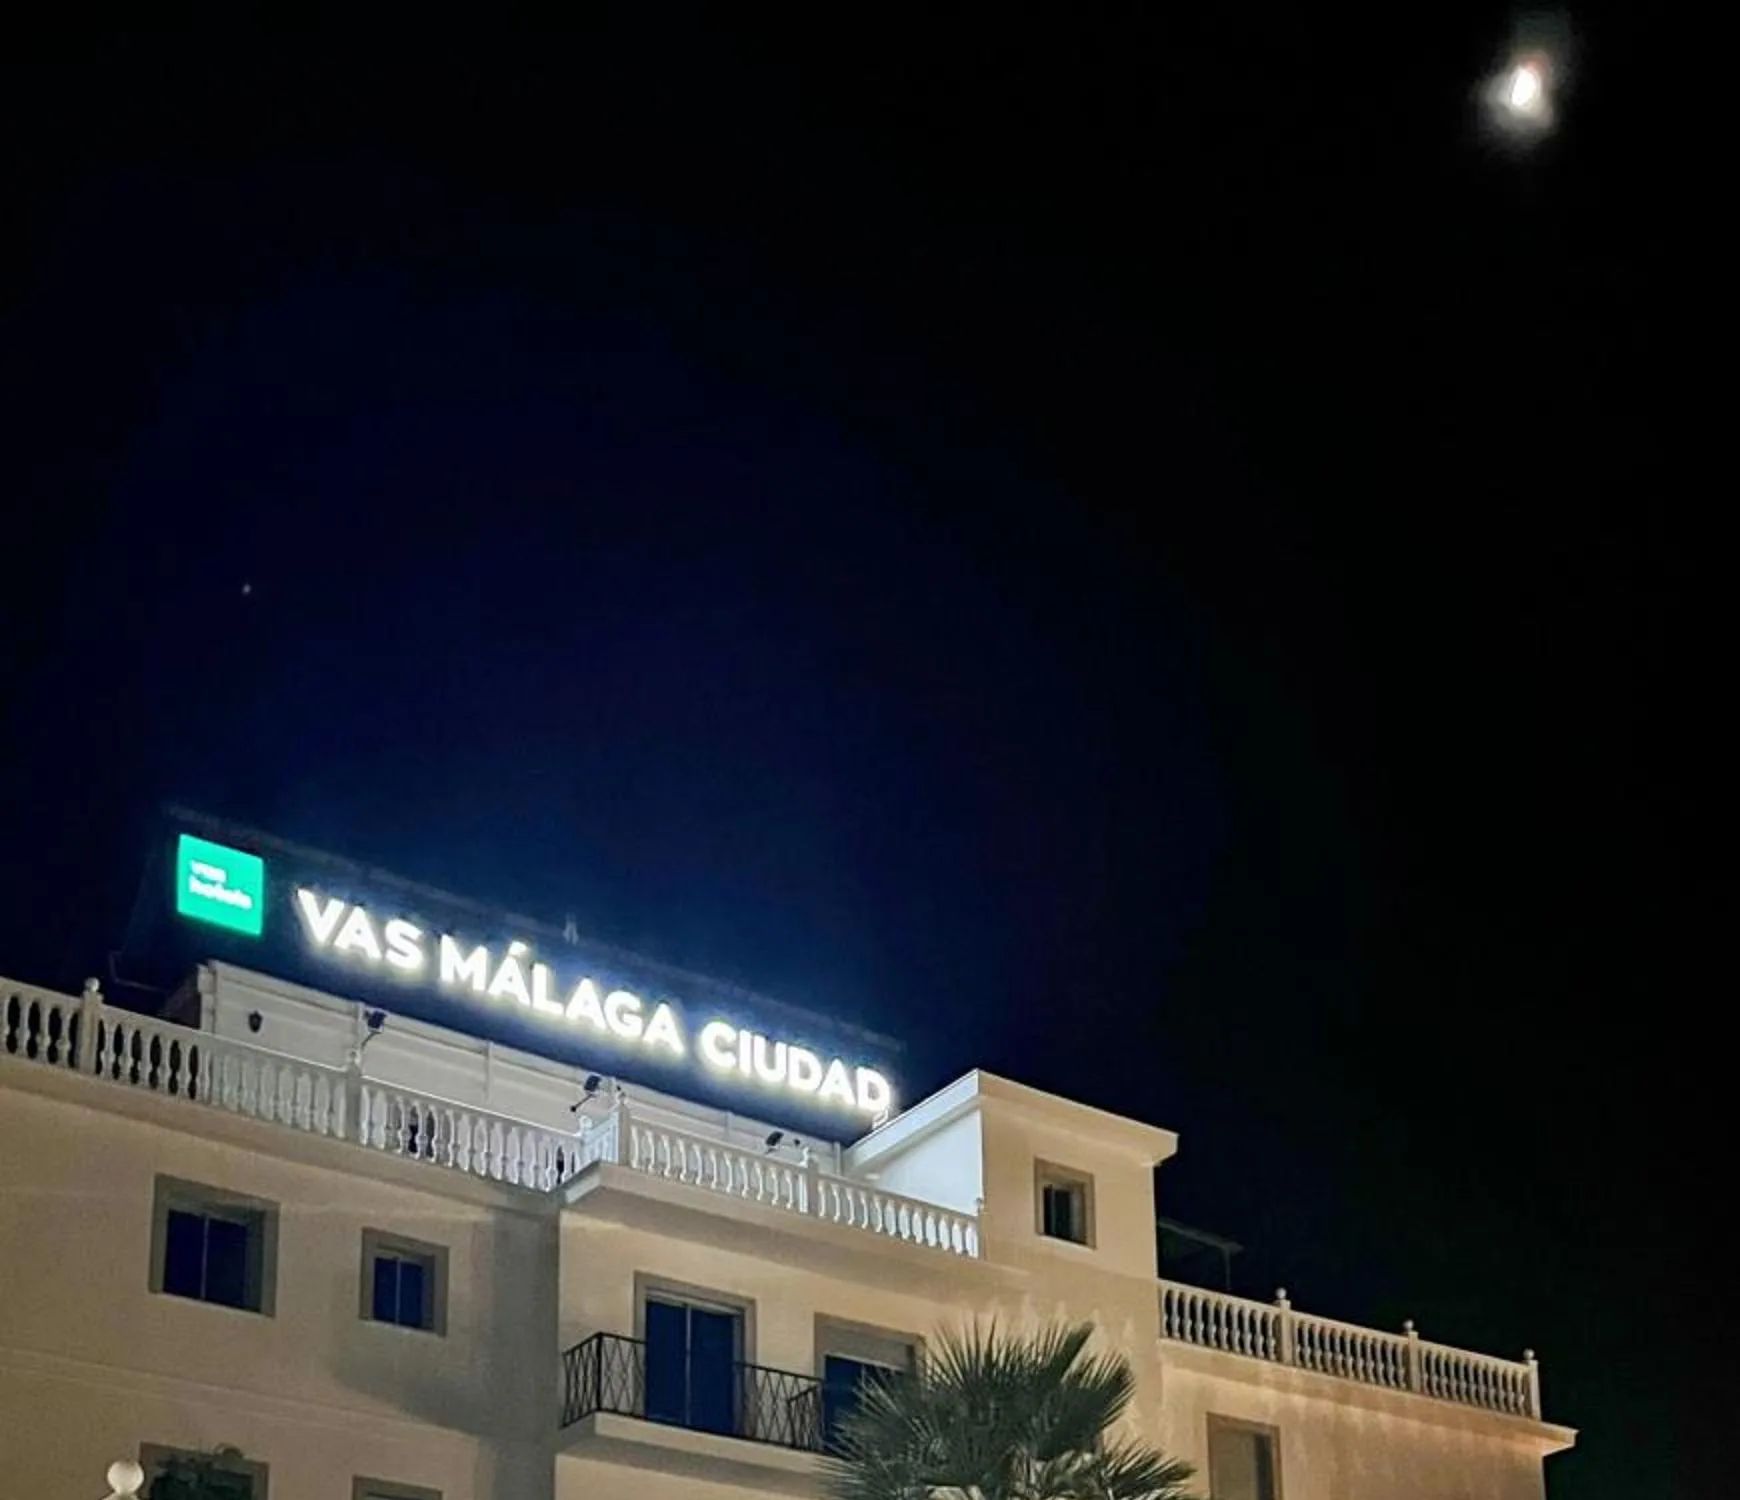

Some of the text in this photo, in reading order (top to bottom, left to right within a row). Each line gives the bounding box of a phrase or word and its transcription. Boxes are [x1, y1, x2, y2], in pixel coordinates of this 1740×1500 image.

[297, 888, 425, 969] VAS
[440, 940, 686, 1054] MÁLAGA
[700, 1021, 891, 1112] CIUDAD
